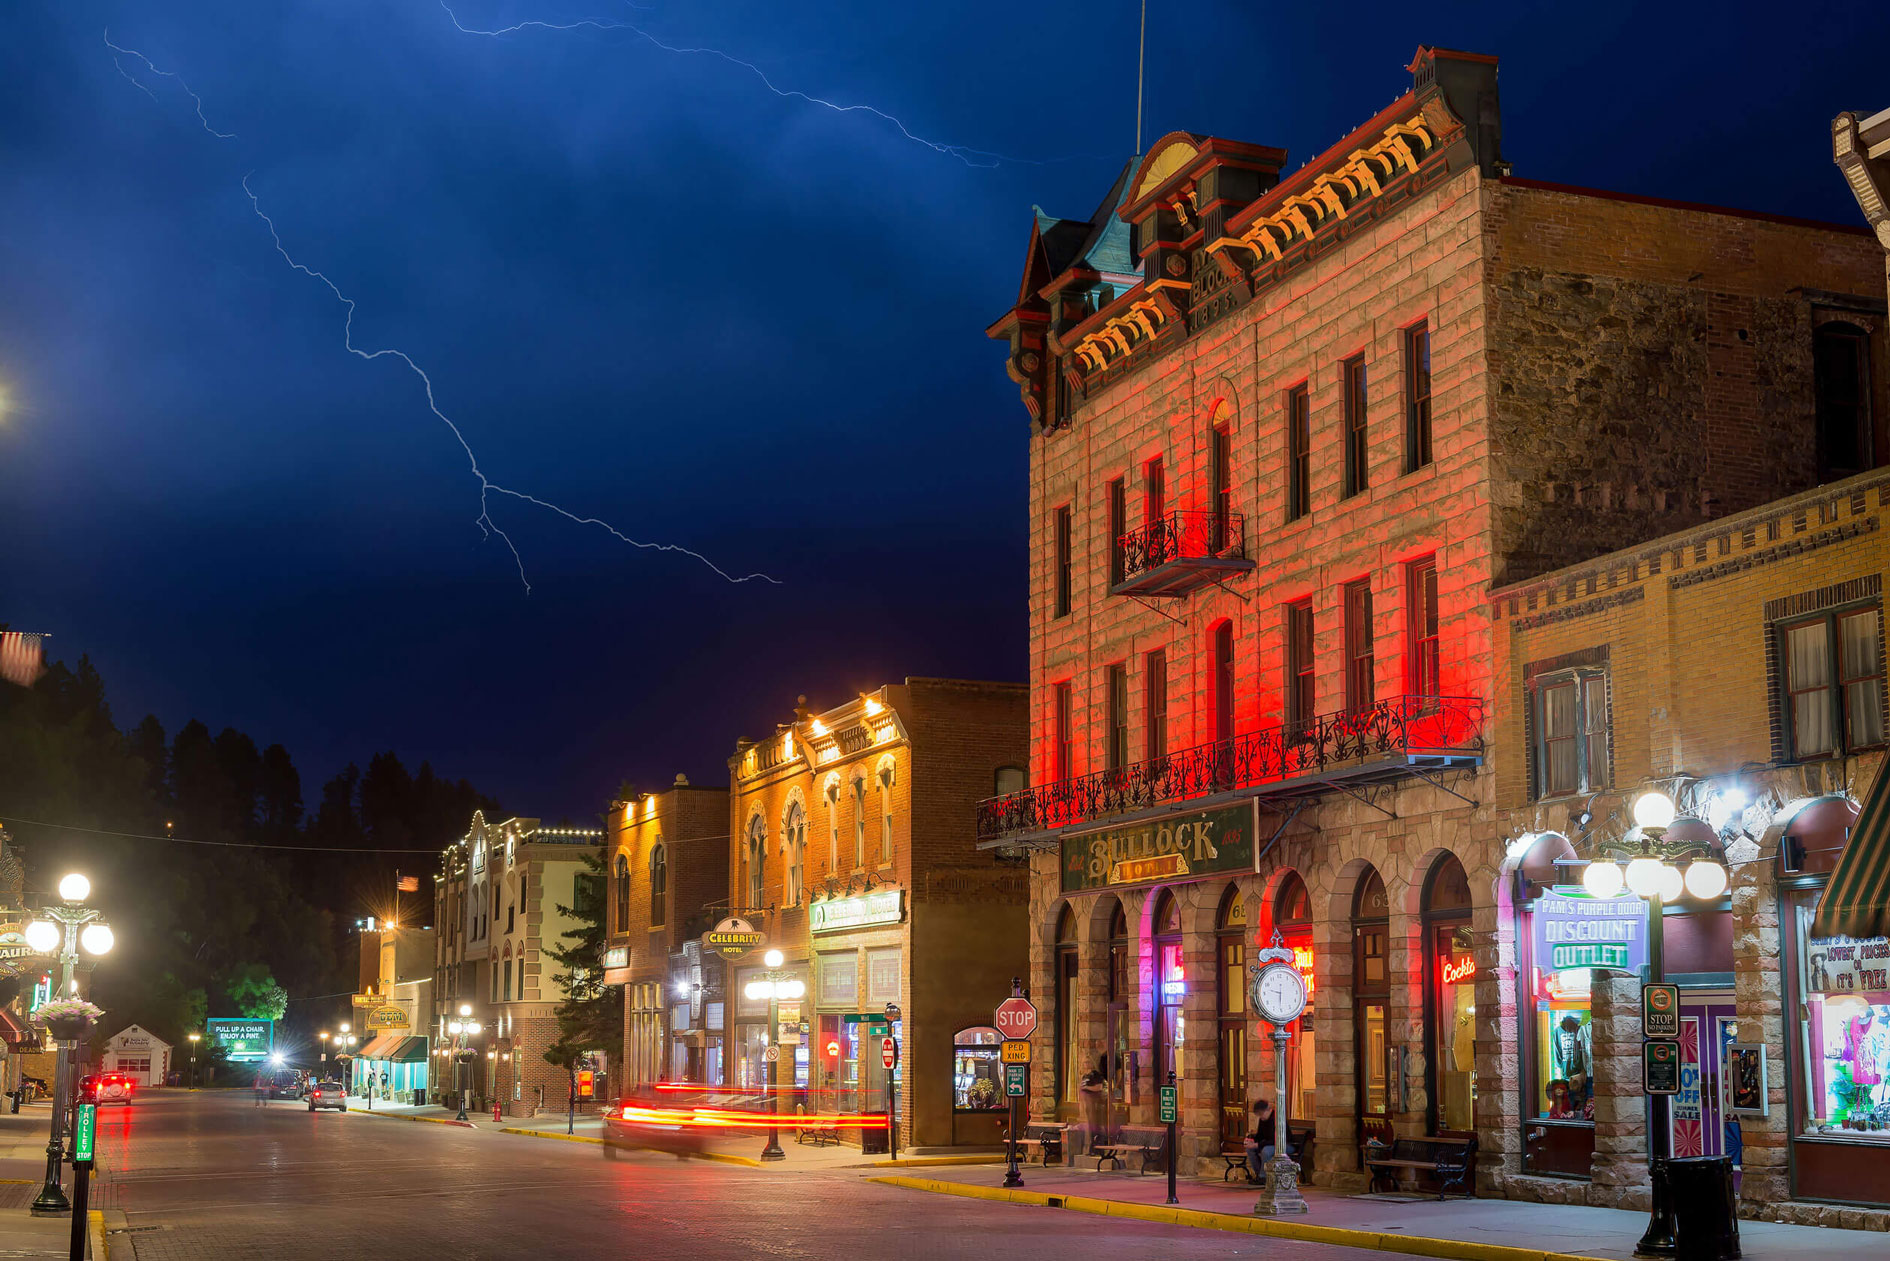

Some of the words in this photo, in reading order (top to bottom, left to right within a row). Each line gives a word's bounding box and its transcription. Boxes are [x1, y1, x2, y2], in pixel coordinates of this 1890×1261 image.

[1089, 821, 1218, 878] BULLOCK
[1542, 899, 1575, 915] PAM'S
[1577, 902, 1616, 916] PURPLE
[1617, 902, 1645, 915] DOOR
[709, 933, 761, 943] CELEBRITY
[1545, 919, 1639, 942] DISCOUNT
[1553, 944, 1629, 968] OUTLET
[1827, 947, 1856, 961] LOWEST
[1860, 943, 1890, 960] PRICES
[1853, 960, 1862, 970] OR
[1836, 973, 1854, 988] IT'S
[1859, 969, 1888, 990] FREE
[999, 1011, 1033, 1026] STOP
[1650, 1014, 1673, 1025] STOP
[1681, 1068, 1699, 1088] 0%
[1674, 1089, 1699, 1103] OFF
[1674, 1111, 1700, 1119] SALE
[81, 1104, 94, 1151] TROLLEY
